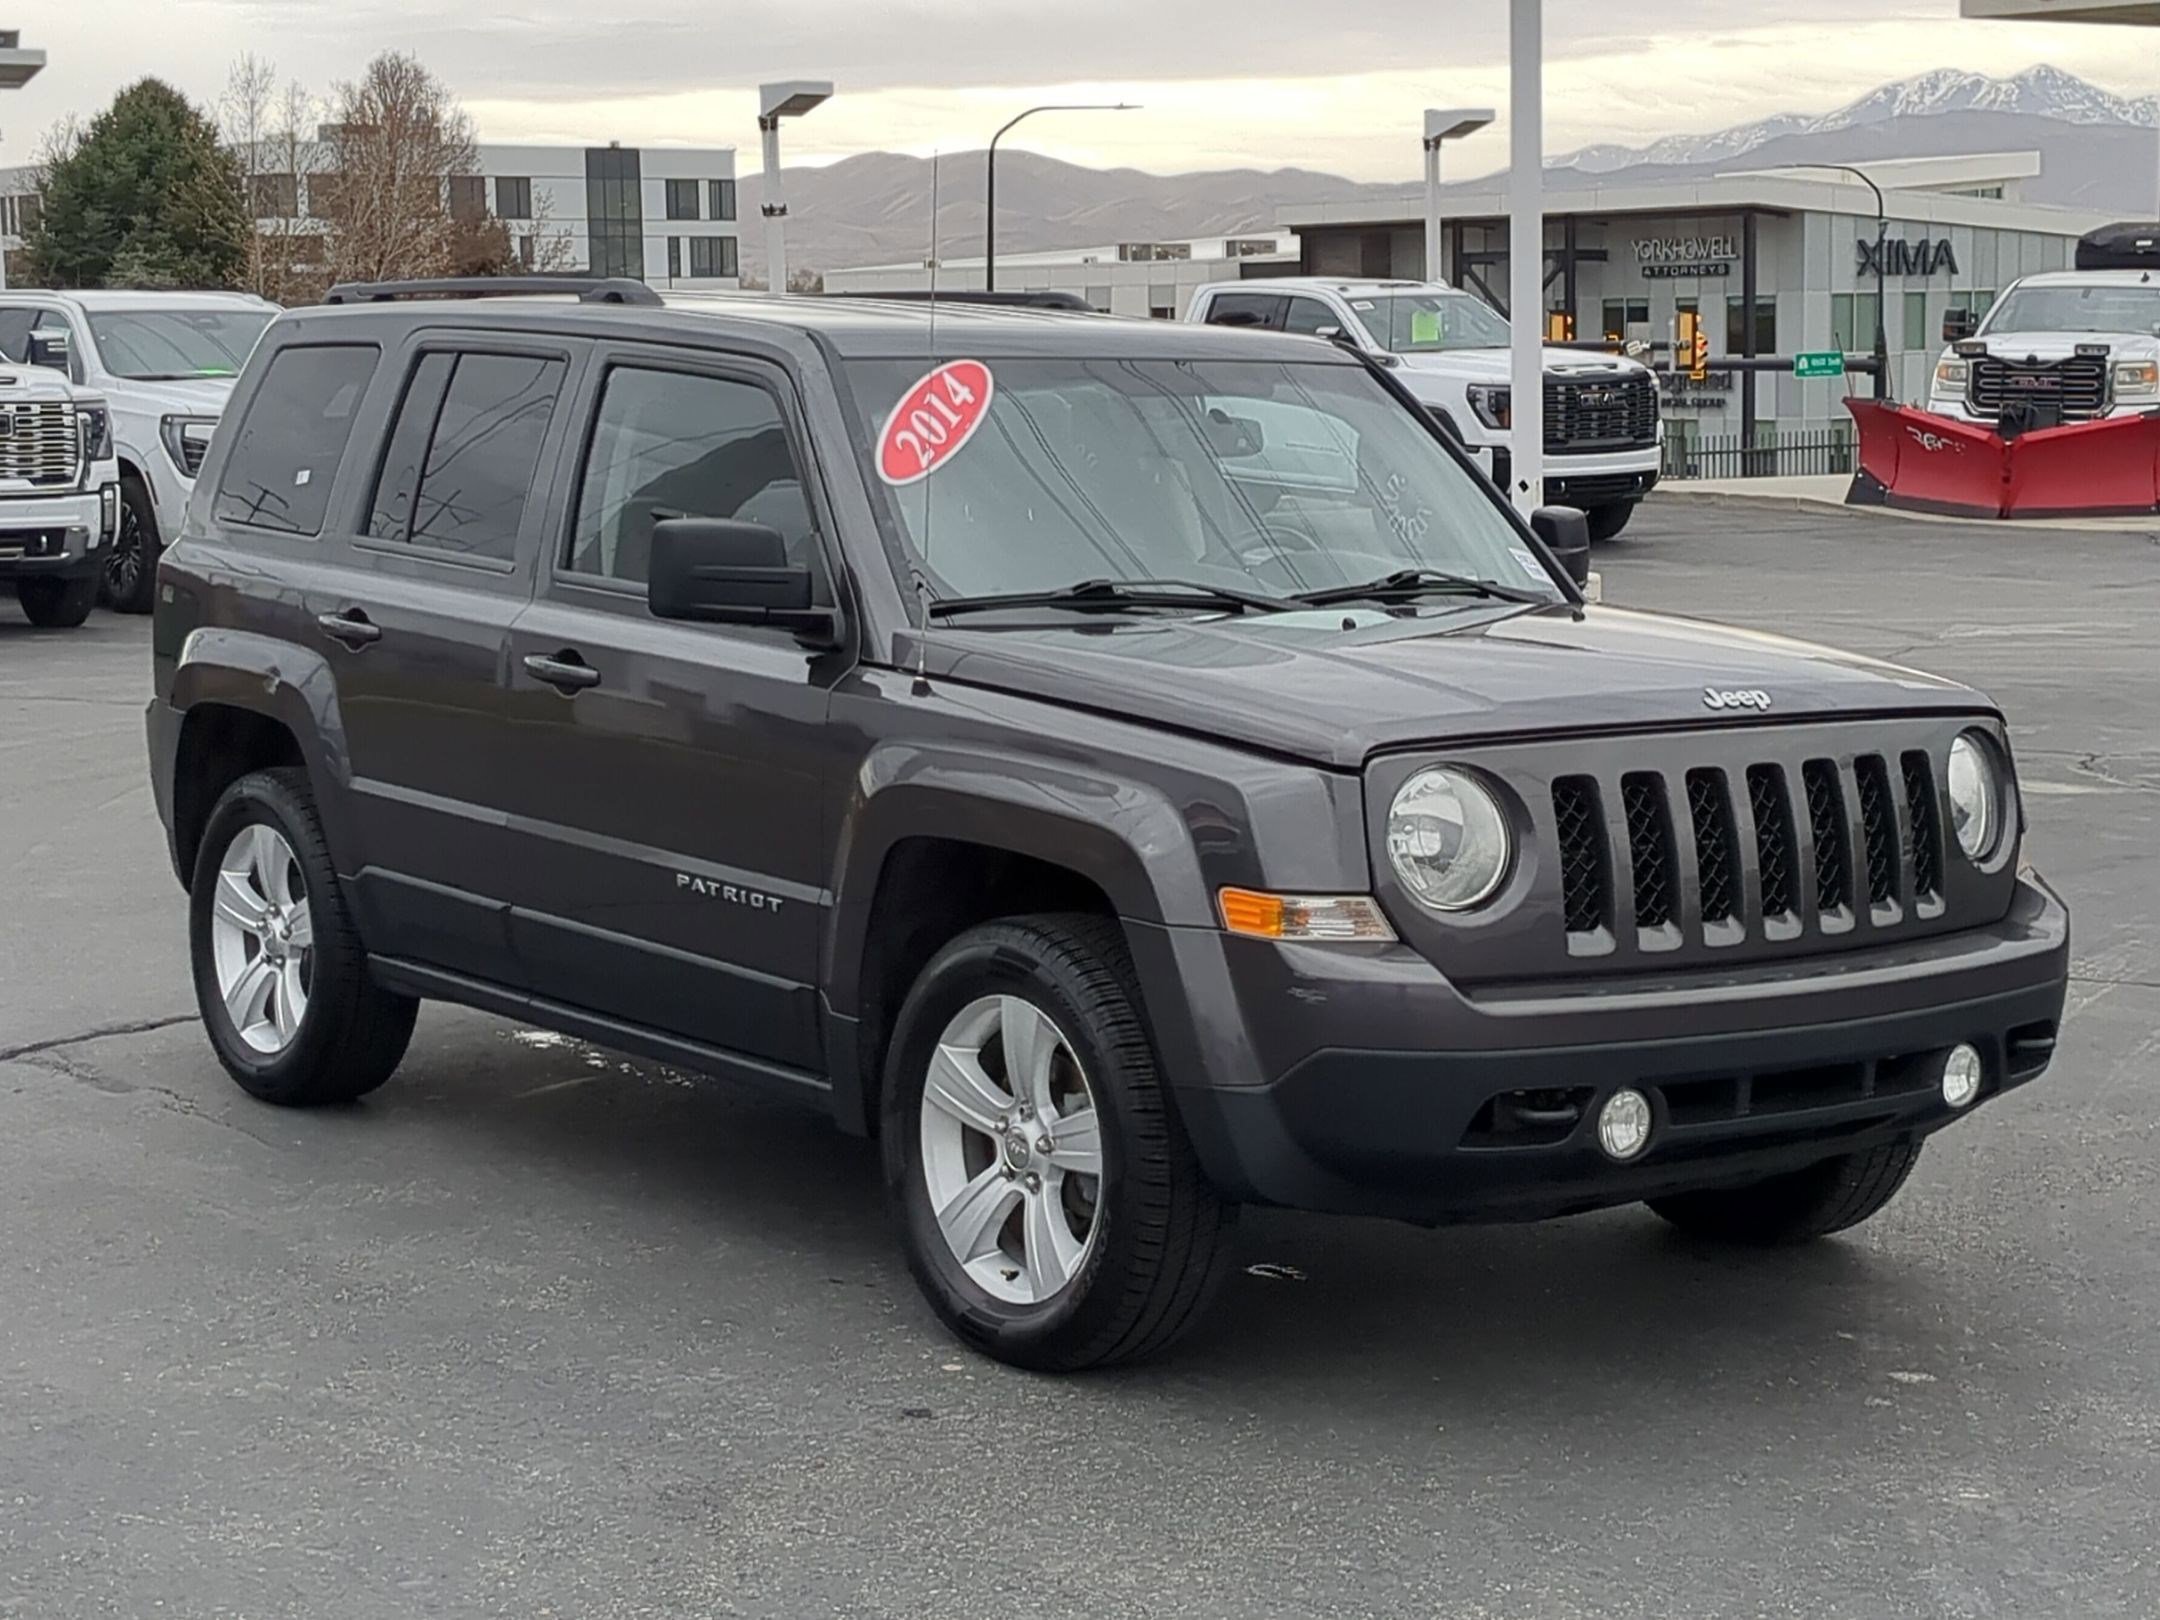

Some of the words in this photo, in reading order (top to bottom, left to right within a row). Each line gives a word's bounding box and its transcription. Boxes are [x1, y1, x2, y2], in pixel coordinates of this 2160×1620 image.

[1643, 263, 1727, 276] ATTORNEYS
[1857, 239, 1959, 276] XIMA
[895, 370, 975, 469] 2014
[1703, 687, 1771, 711] Jeep
[676, 873, 783, 912] PATRIOT
